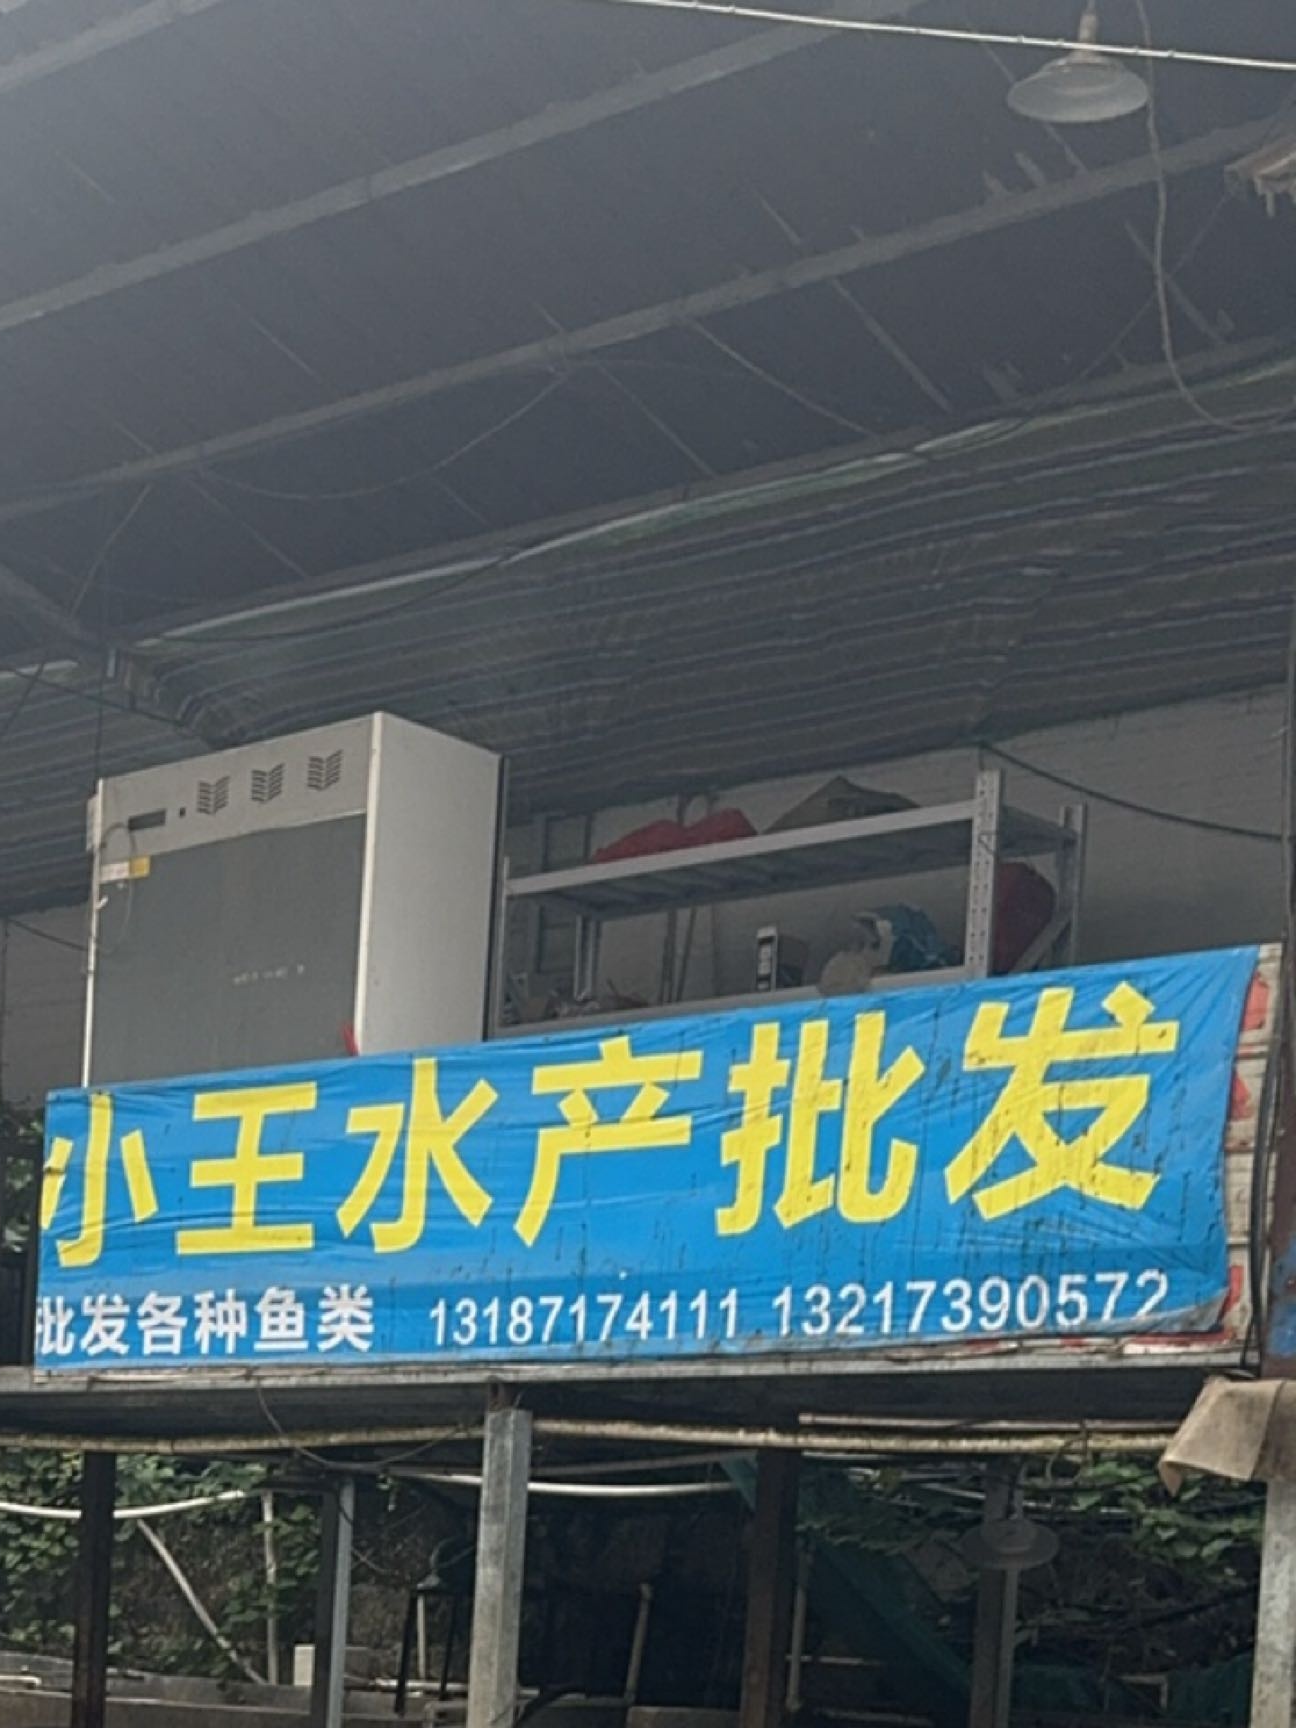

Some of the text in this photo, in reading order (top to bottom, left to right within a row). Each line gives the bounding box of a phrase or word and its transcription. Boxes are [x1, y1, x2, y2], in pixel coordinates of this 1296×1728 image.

[40, 982, 1180, 1266] 小王水产批发
[35, 1268, 1168, 1354] 批发各种鱼类 13187174111 13217390572
